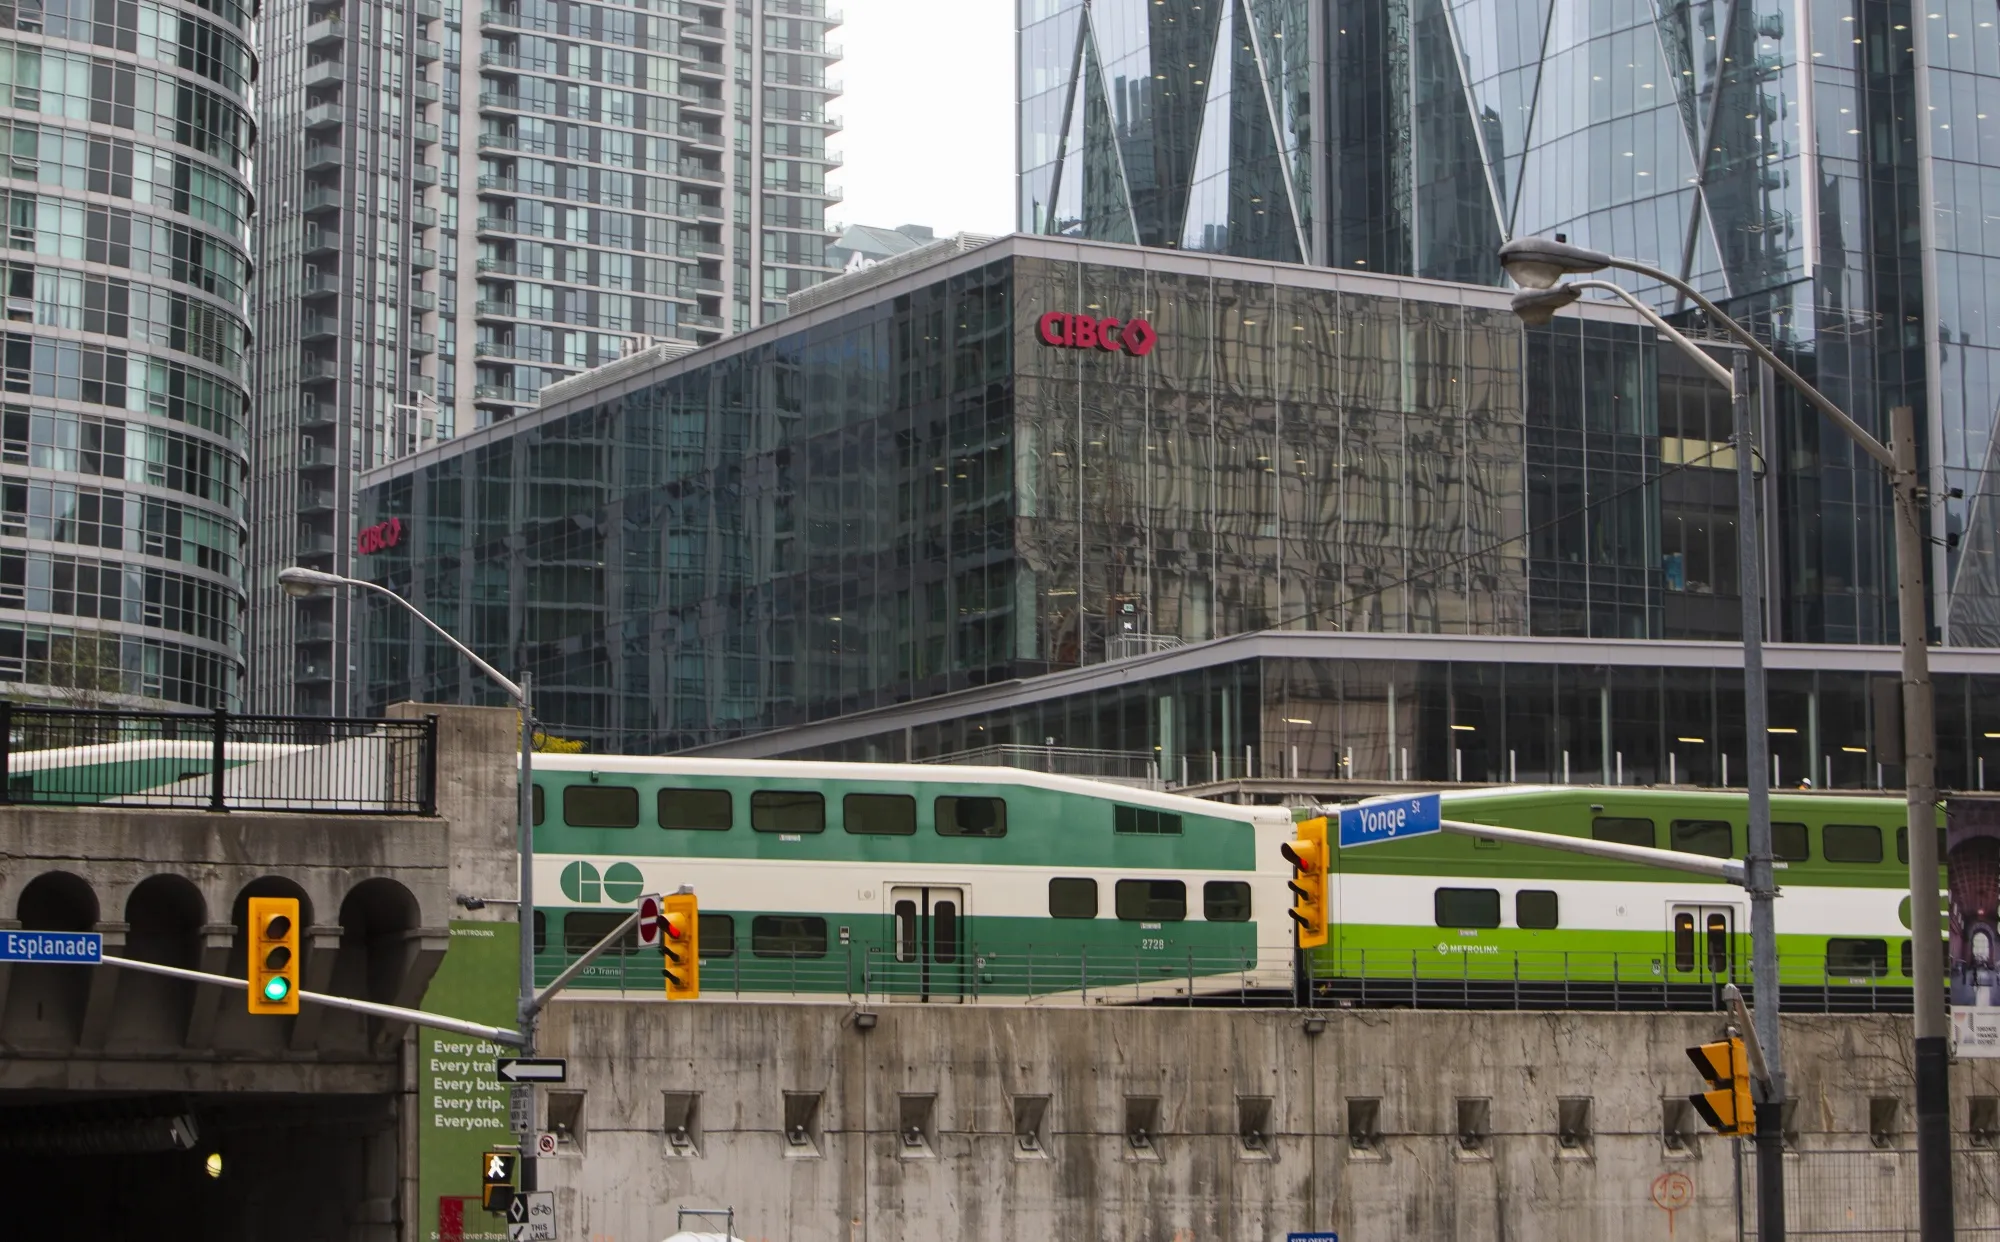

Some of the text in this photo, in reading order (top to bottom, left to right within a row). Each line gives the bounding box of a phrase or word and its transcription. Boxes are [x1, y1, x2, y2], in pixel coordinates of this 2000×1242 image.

[1039, 311, 1120, 351] CIBC
[357, 522, 388, 555] CIBC
[1360, 800, 1420, 836] Yonge St
[560, 860, 644, 904] GO
[8, 934, 97, 959] Esplanade
[1142, 938, 1164, 950] 2728
[1449, 944, 1499, 954] METROLINX
[583, 967, 623, 975] GO Transi
[434, 1040, 505, 1056] Every day.
[430, 1059, 497, 1075] Every trai
[434, 1077, 505, 1093] Every bus.
[434, 1096, 505, 1112] Every trip.
[435, 1114, 504, 1131] Everyone.
[1660, 1178, 1687, 1201] 15
[531, 1223, 548, 1231] THIS
[483, 1231, 507, 1241] Stops
[529, 1231, 550, 1240] LANE
